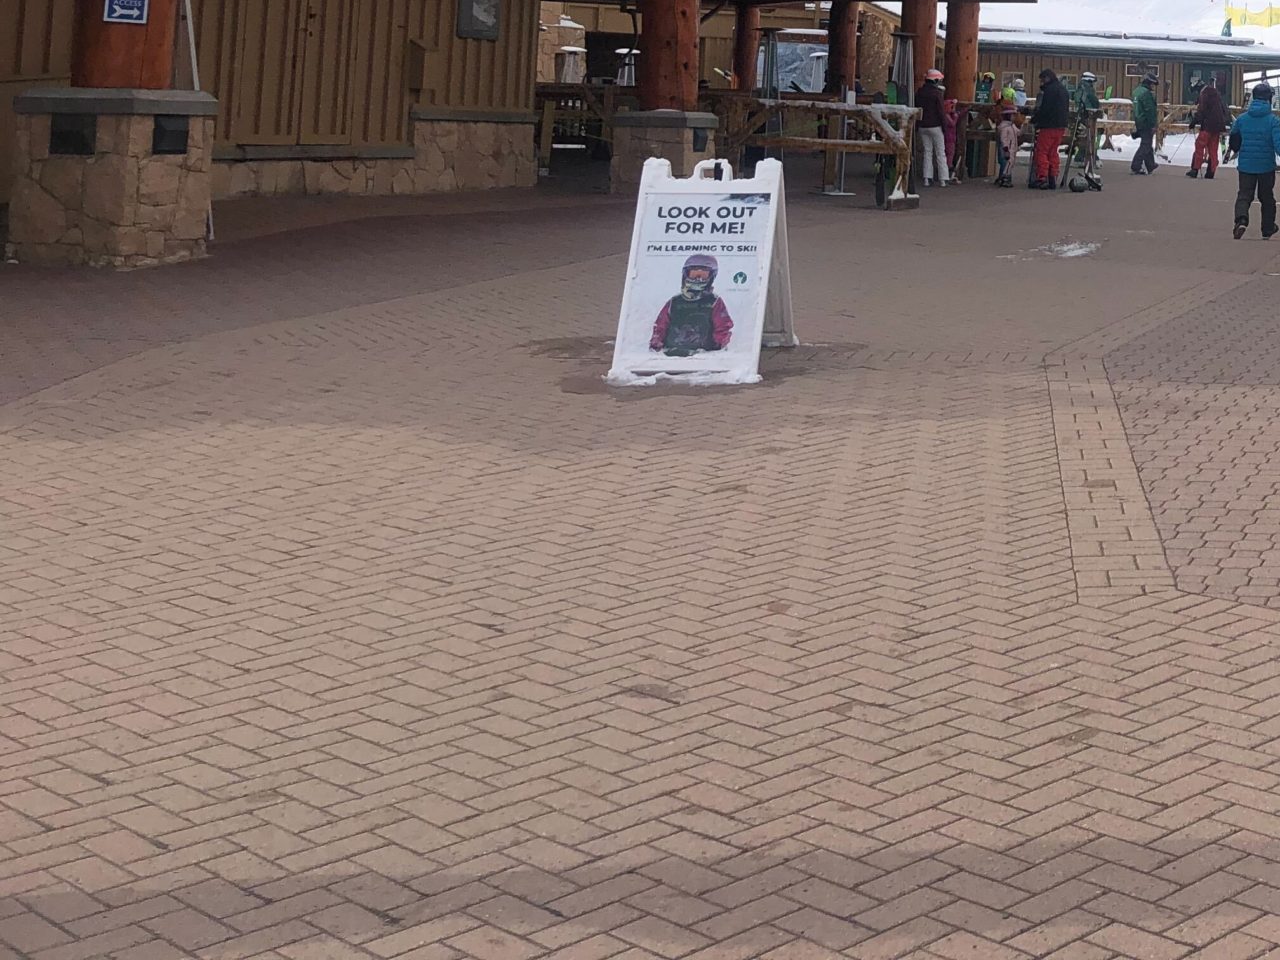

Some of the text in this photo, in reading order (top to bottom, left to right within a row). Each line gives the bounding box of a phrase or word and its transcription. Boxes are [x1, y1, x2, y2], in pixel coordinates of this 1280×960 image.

[113, 0, 142, 7] ACCESS
[657, 206, 757, 219] LOOK OUT
[664, 222, 746, 235] FOR ME!
